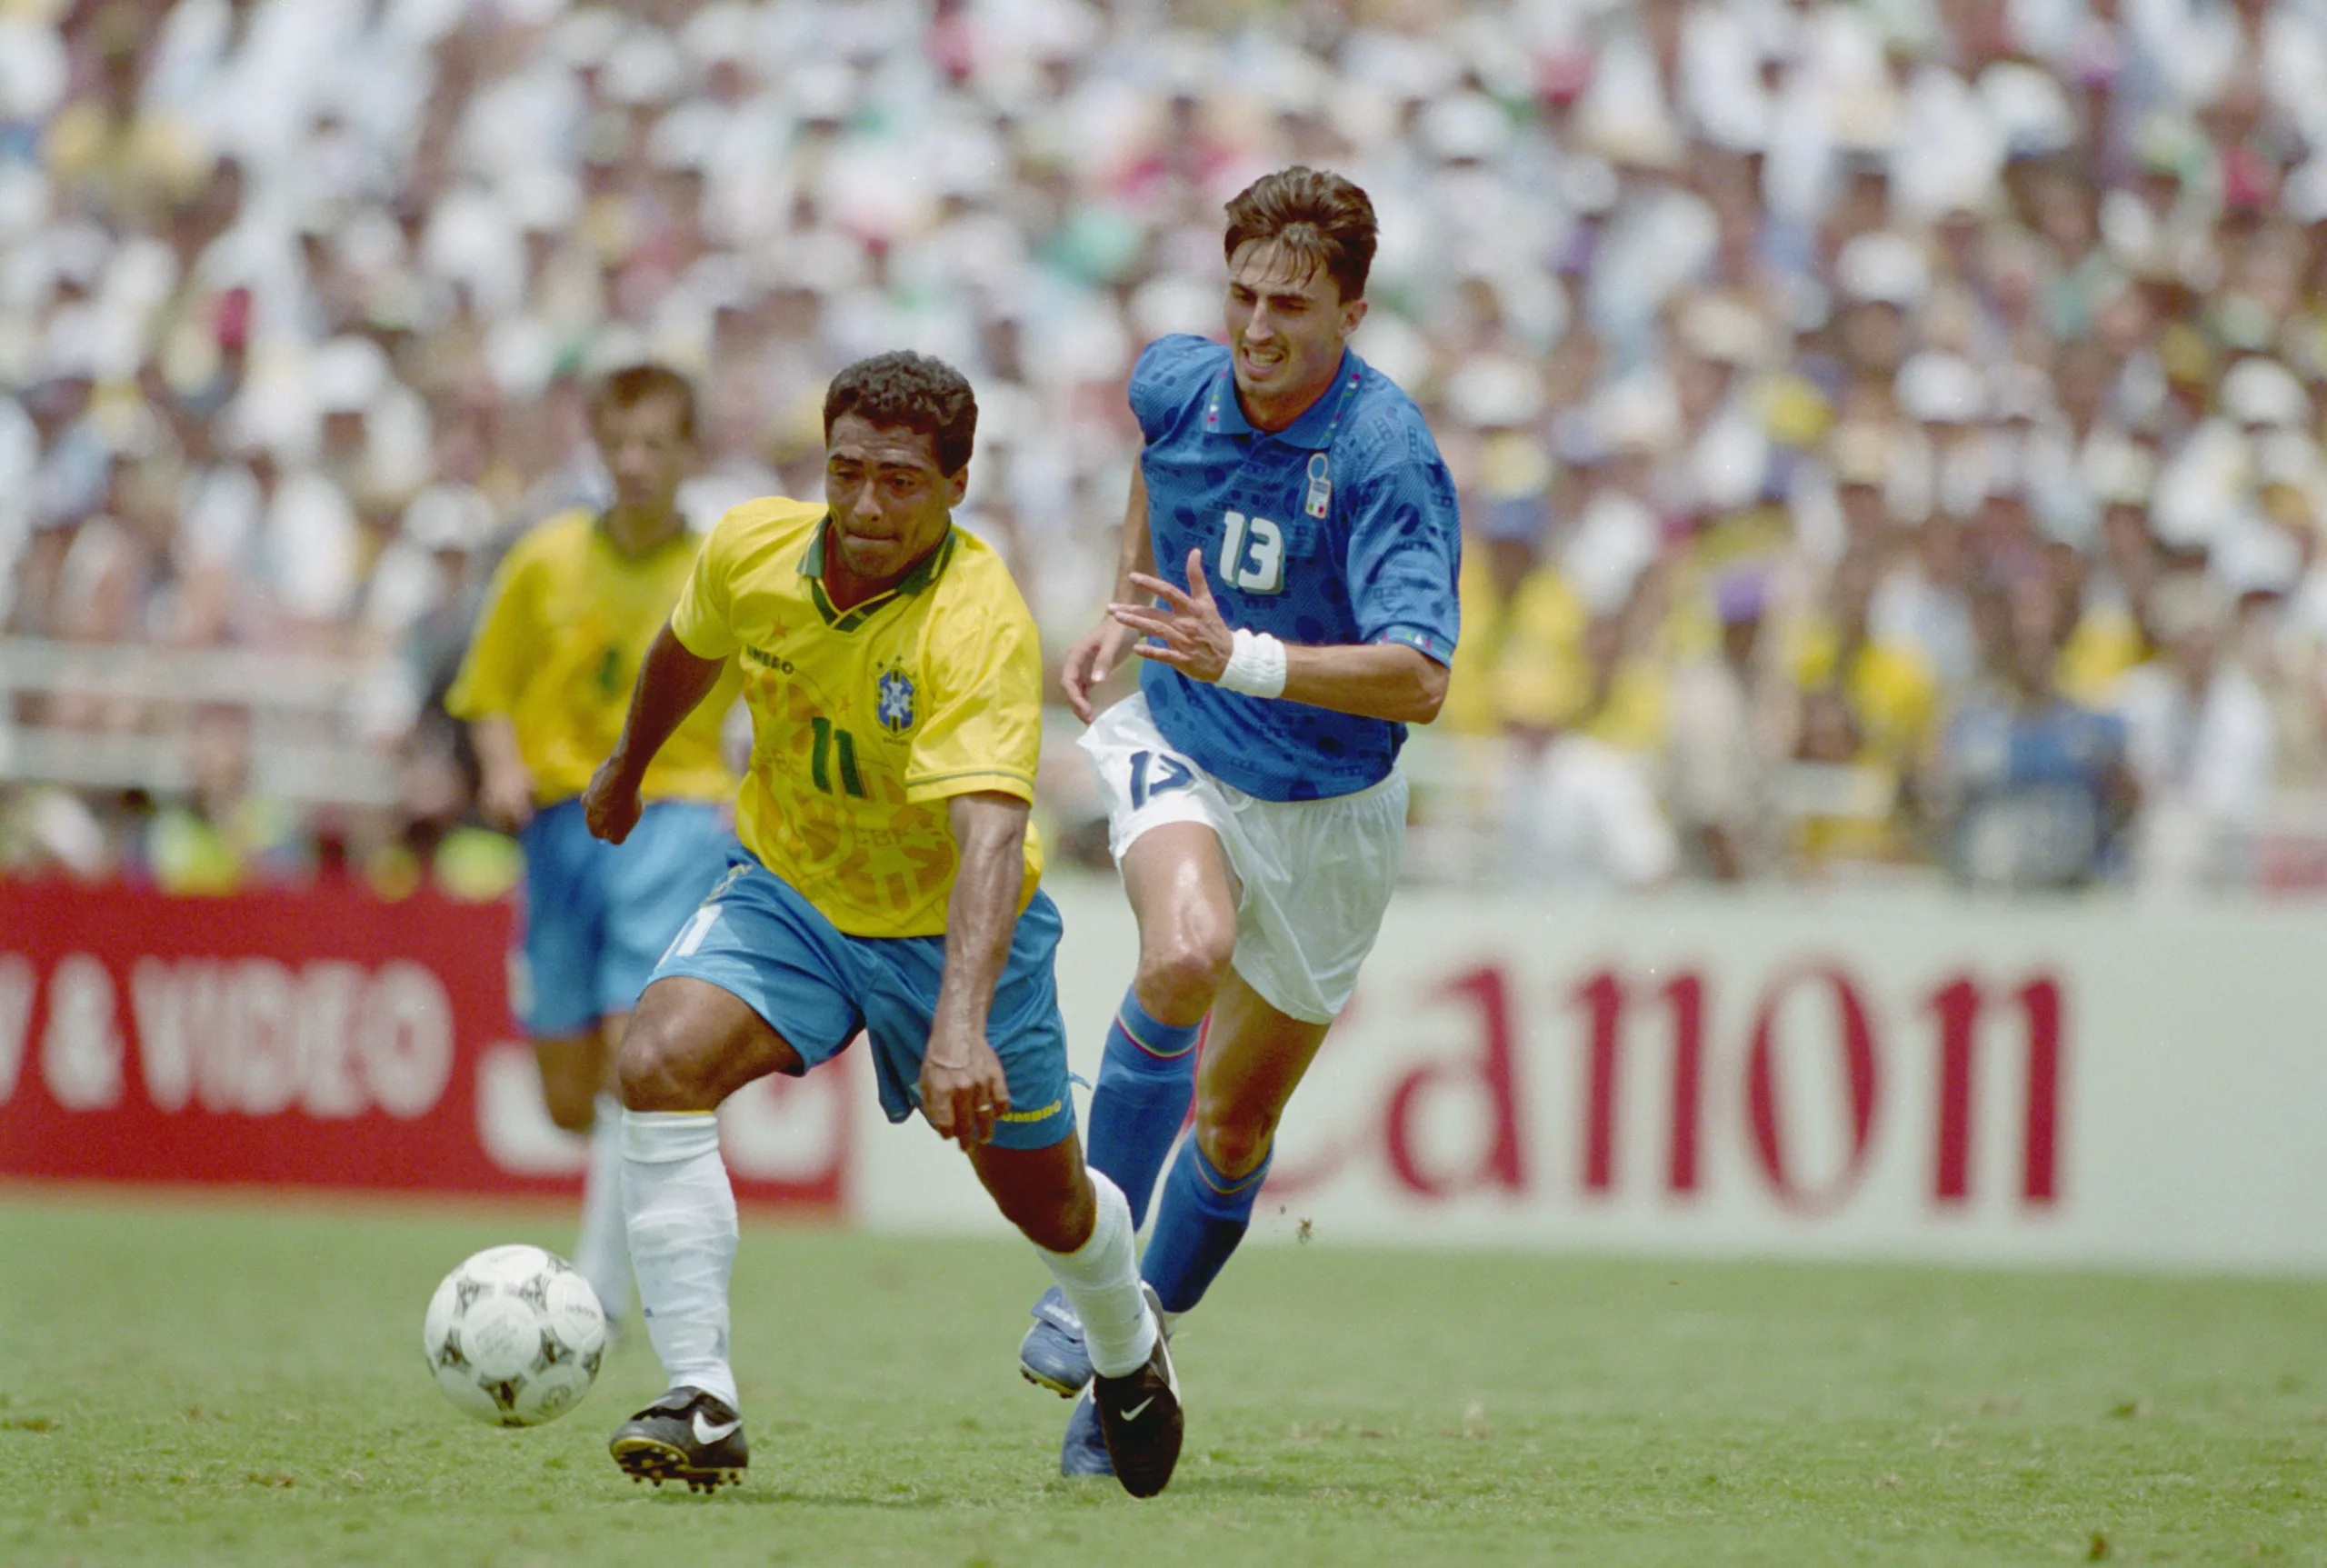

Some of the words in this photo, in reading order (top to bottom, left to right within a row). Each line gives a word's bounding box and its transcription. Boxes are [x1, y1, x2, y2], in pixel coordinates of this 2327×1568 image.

[1219, 510, 1284, 593] 13
[811, 717, 866, 798] 11
[42, 952, 125, 1111] &
[131, 954, 454, 1118] VIDEO
